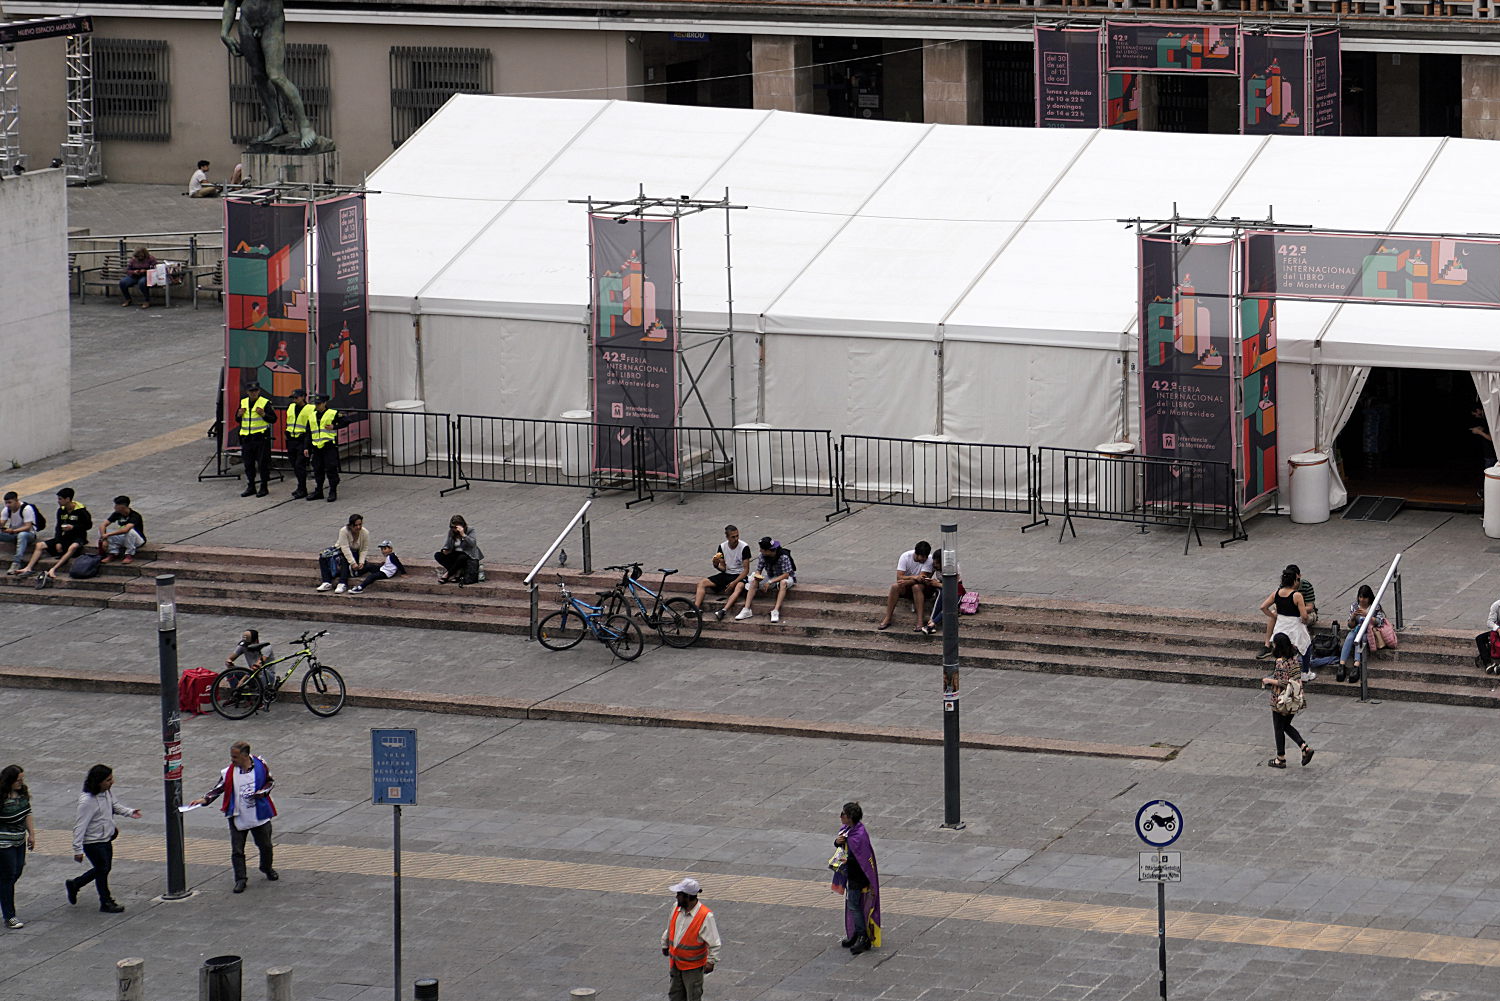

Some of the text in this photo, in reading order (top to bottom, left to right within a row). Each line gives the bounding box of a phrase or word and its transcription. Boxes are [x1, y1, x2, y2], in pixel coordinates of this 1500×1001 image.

[36, 26, 54, 34] ESPACIO
[1283, 266, 1356, 274] INTERNACIONAL
[1297, 282, 1346, 290] Montevideo
[606, 363, 668, 374] INTERNACIONAL
[1156, 392, 1223, 403] INTERNACIONAL
[1170, 410, 1215, 418] Montevideo
